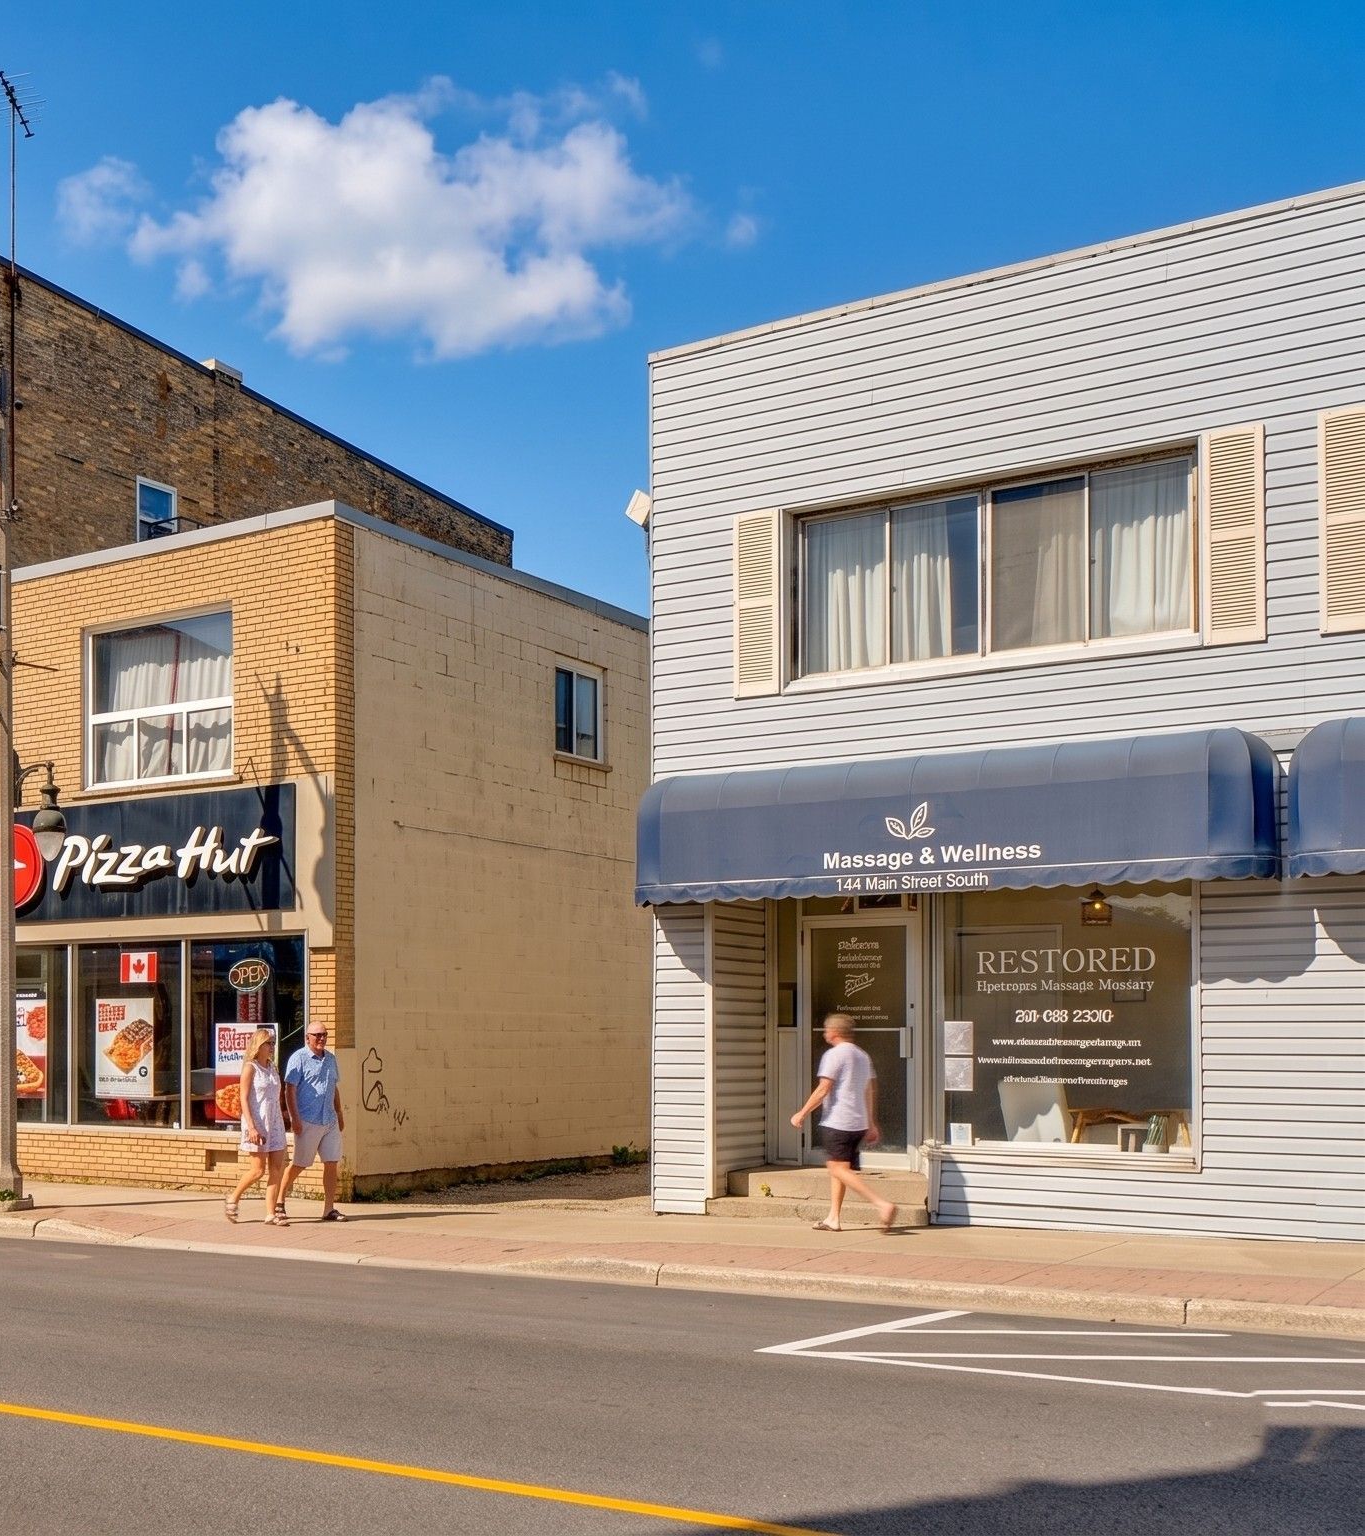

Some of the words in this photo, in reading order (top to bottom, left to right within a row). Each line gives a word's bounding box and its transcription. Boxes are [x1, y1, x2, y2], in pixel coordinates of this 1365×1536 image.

[52, 833, 173, 892] Pizza
[176, 825, 280, 880] Hut
[823, 851, 914, 871] Massage
[919, 846, 935, 865] &
[940, 843, 1042, 864] Wellness
[836, 877, 862, 892] 144
[865, 875, 898, 891] Main
[901, 874, 943, 889] Street
[945, 872, 989, 888] South
[976, 947, 1156, 975] RESTORED
